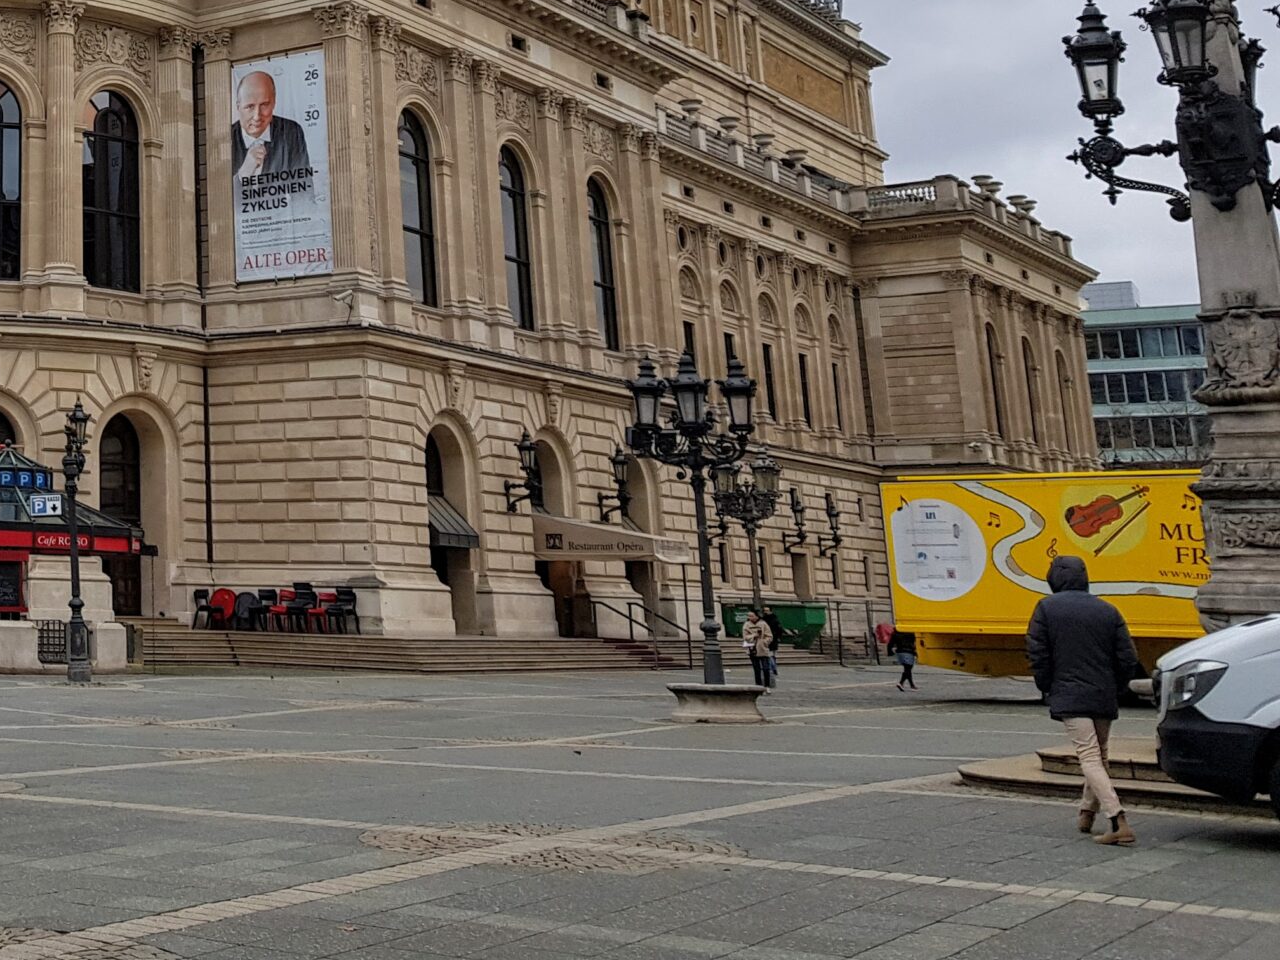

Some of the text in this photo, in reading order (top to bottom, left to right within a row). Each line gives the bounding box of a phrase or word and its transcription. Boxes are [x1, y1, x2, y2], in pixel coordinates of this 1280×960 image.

[304, 69, 319, 81] 26
[304, 110, 320, 122] 30
[242, 167, 319, 187] BEETHOVEN-
[241, 181, 312, 200] SINFONIEN-
[241, 197, 288, 213] ZYKLUS
[242, 252, 282, 270] ALTE
[285, 248, 327, 265] OPER
[1, 474, 11, 485] P
[20, 475, 29, 486] P
[36, 476, 43, 487] P
[34, 501, 44, 513] P
[37, 535, 57, 546] Café
[568, 541, 614, 551] Restaurant
